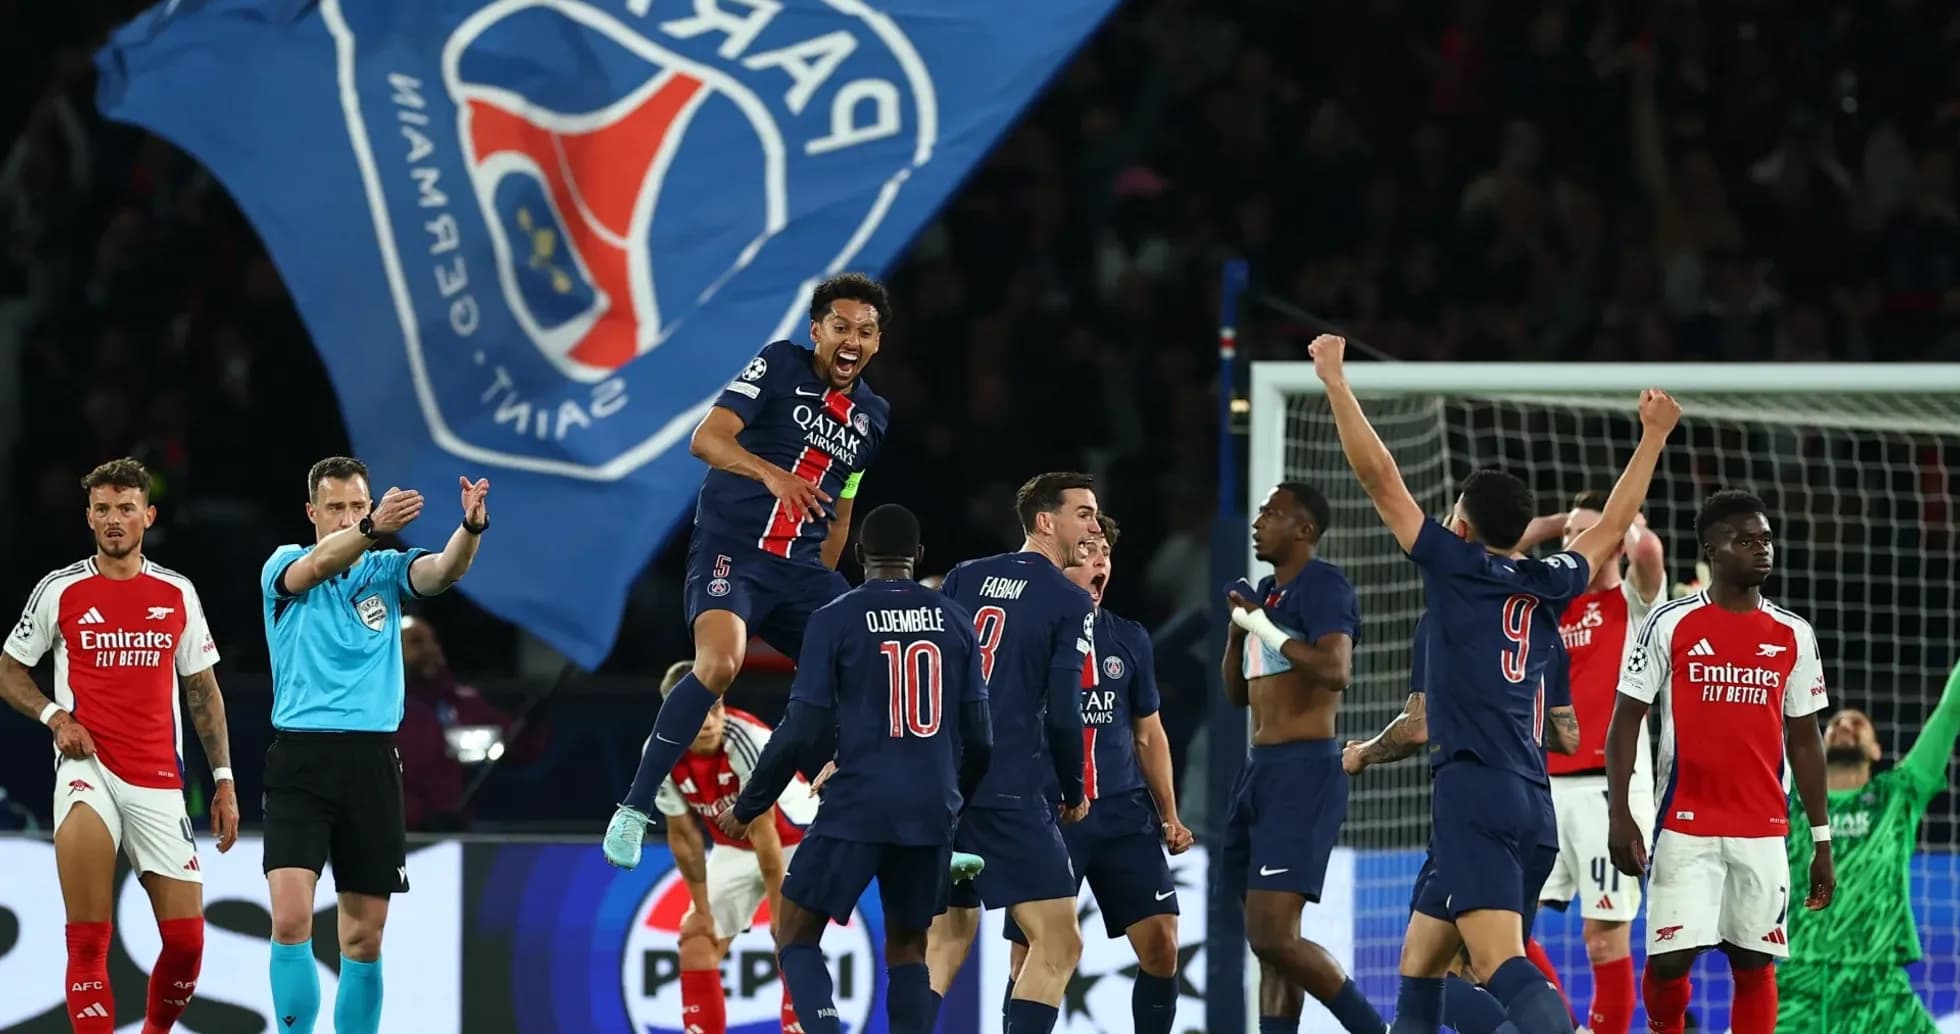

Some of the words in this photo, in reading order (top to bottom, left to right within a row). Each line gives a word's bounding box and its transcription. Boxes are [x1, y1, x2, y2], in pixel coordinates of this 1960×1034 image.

[793, 404, 861, 455] QATAR
[804, 431, 857, 466] AIRWAYS
[713, 554, 732, 578] 5
[80, 628, 173, 650] Emirates
[1501, 594, 1540, 683] 9
[96, 651, 116, 668] FLY
[119, 650, 160, 668] BETTER
[1688, 662, 1781, 688] Emirates
[880, 639, 943, 739] 10
[1702, 685, 1722, 702] FLY
[1726, 687, 1769, 705] BETTER
[1081, 711, 1113, 724] WAYS
[72, 980, 104, 993] AFC
[642, 951, 855, 999] PPI
